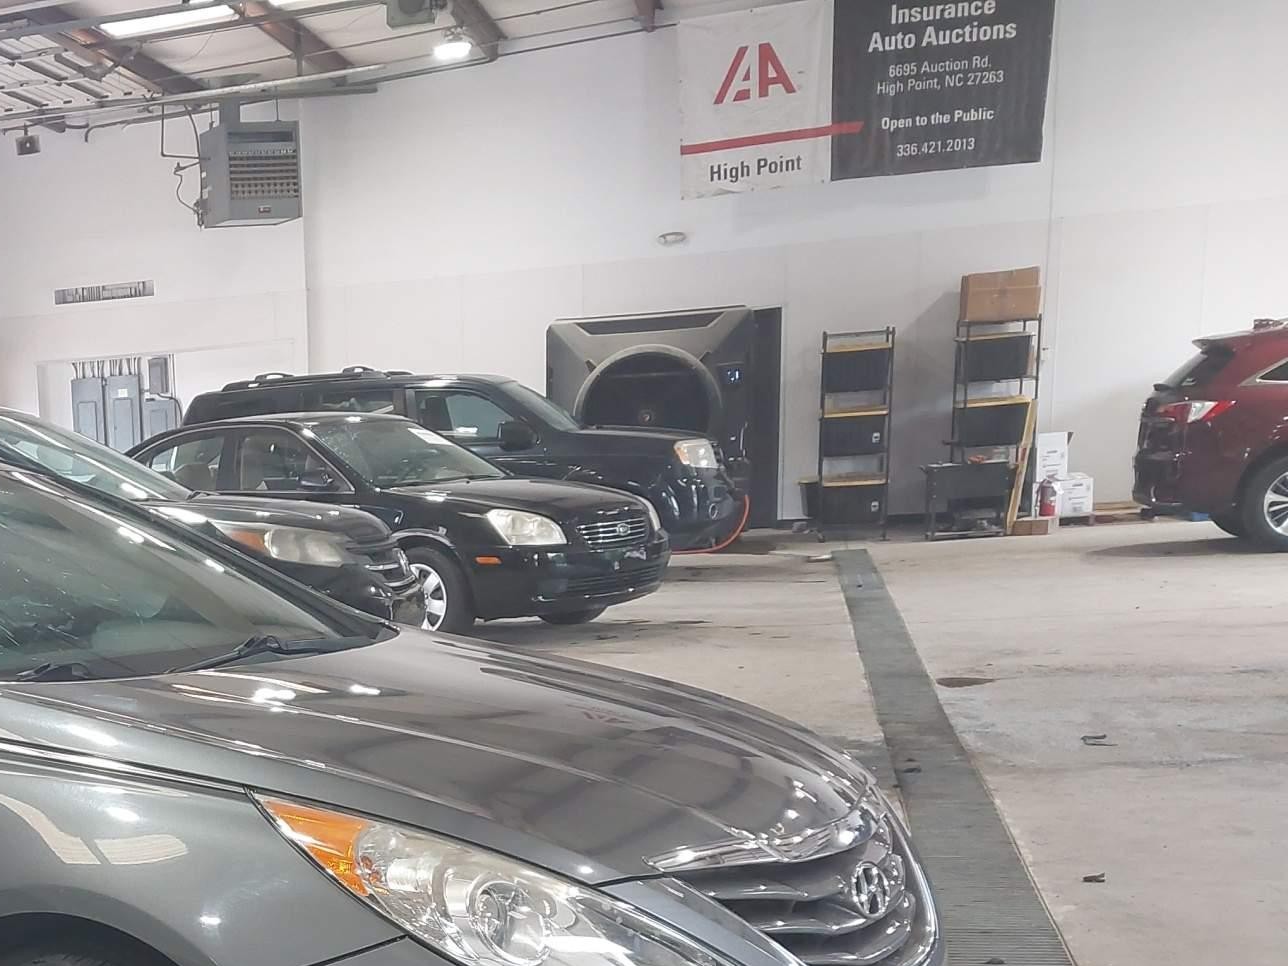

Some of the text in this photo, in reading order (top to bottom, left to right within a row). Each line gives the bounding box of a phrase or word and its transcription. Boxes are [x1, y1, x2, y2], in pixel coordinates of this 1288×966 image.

[890, 0, 996, 25] Insurance
[868, 21, 1017, 53] Auto Auctions
[888, 55, 992, 78] 6695 Auction Rd.
[876, 70, 1005, 97] High Point, NC 27263
[881, 107, 995, 133] Open to the Public
[896, 137, 976, 157] 336.421.2013
[710, 155, 803, 183] High Point
